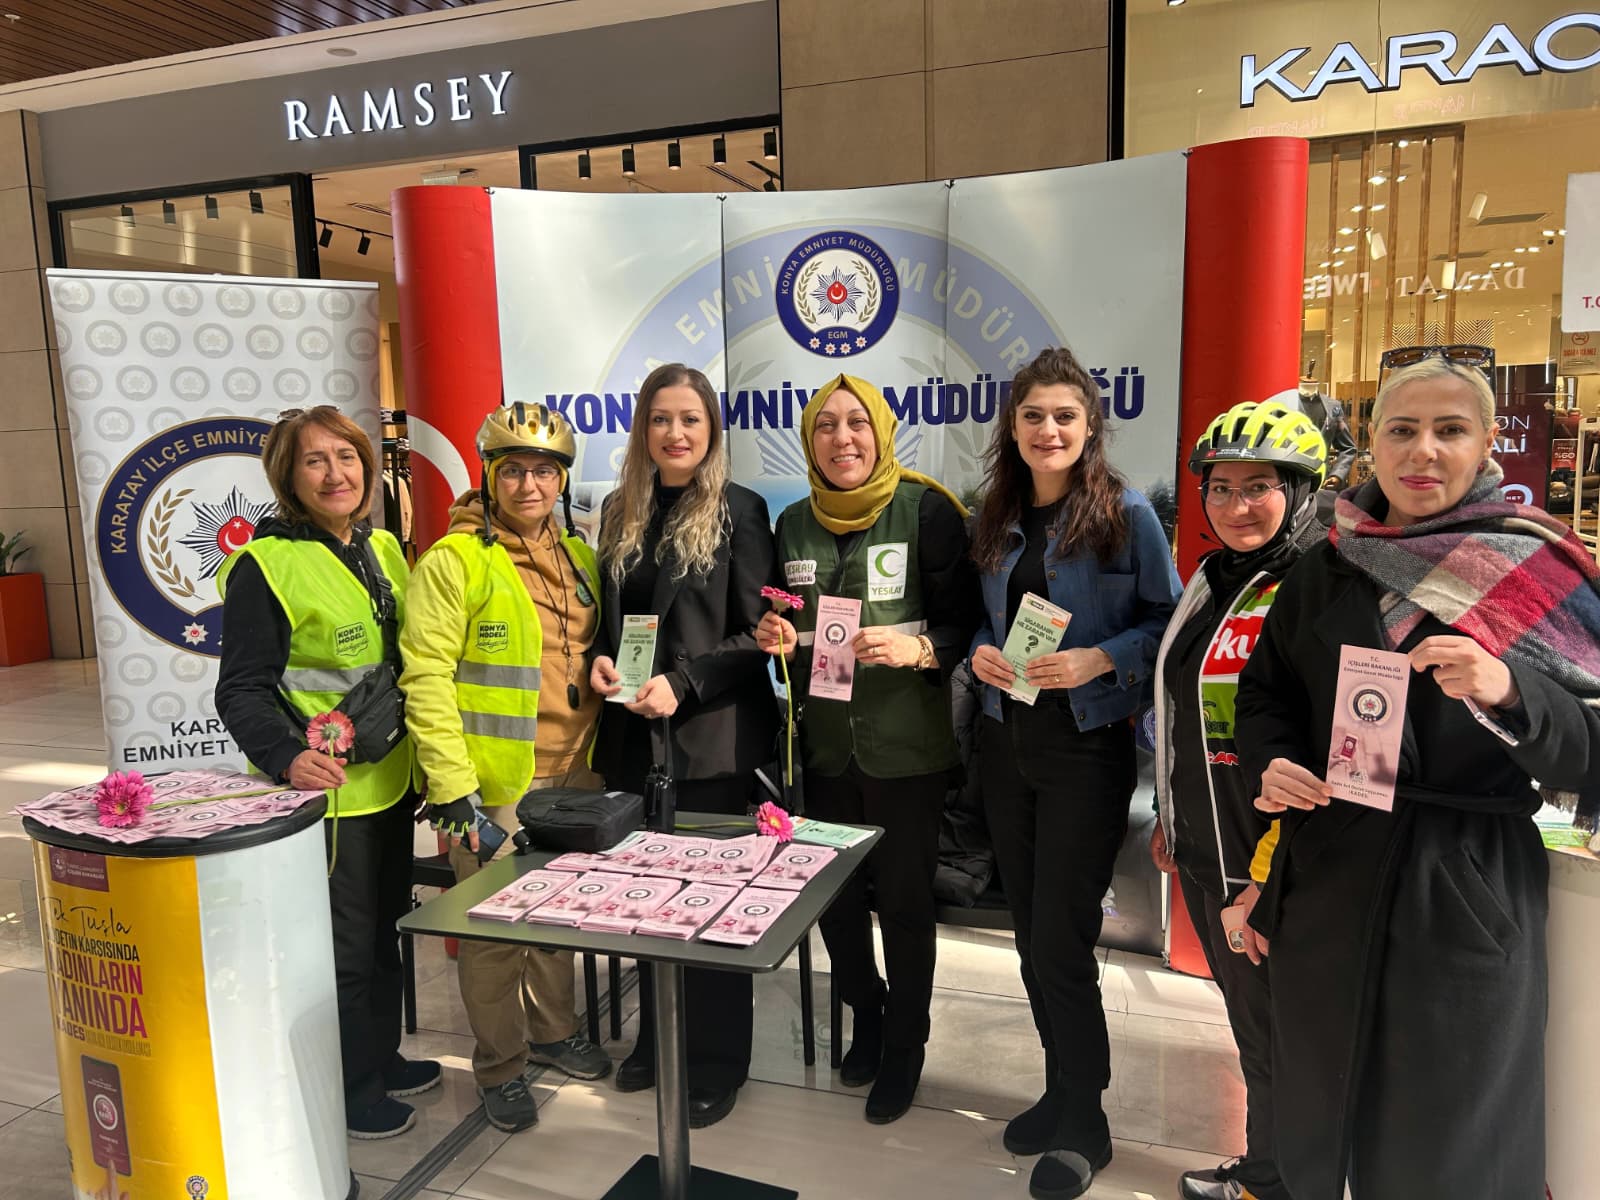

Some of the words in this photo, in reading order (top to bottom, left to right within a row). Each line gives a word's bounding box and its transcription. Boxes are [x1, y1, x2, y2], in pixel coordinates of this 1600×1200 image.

[283, 71, 513, 140] RAMSEY
[781, 260, 799, 294] KONYA
[799, 236, 844, 258] EMNİYET
[848, 238, 895, 291] MÜDÜRLÜĞÜ
[827, 331, 849, 339] EGM
[111, 469, 147, 554] KARATAY
[144, 440, 190, 472] İLÇE
[193, 427, 269, 449] EMNİYE
[171, 719, 229, 736] KAR
[123, 740, 229, 763] EMNİYET
